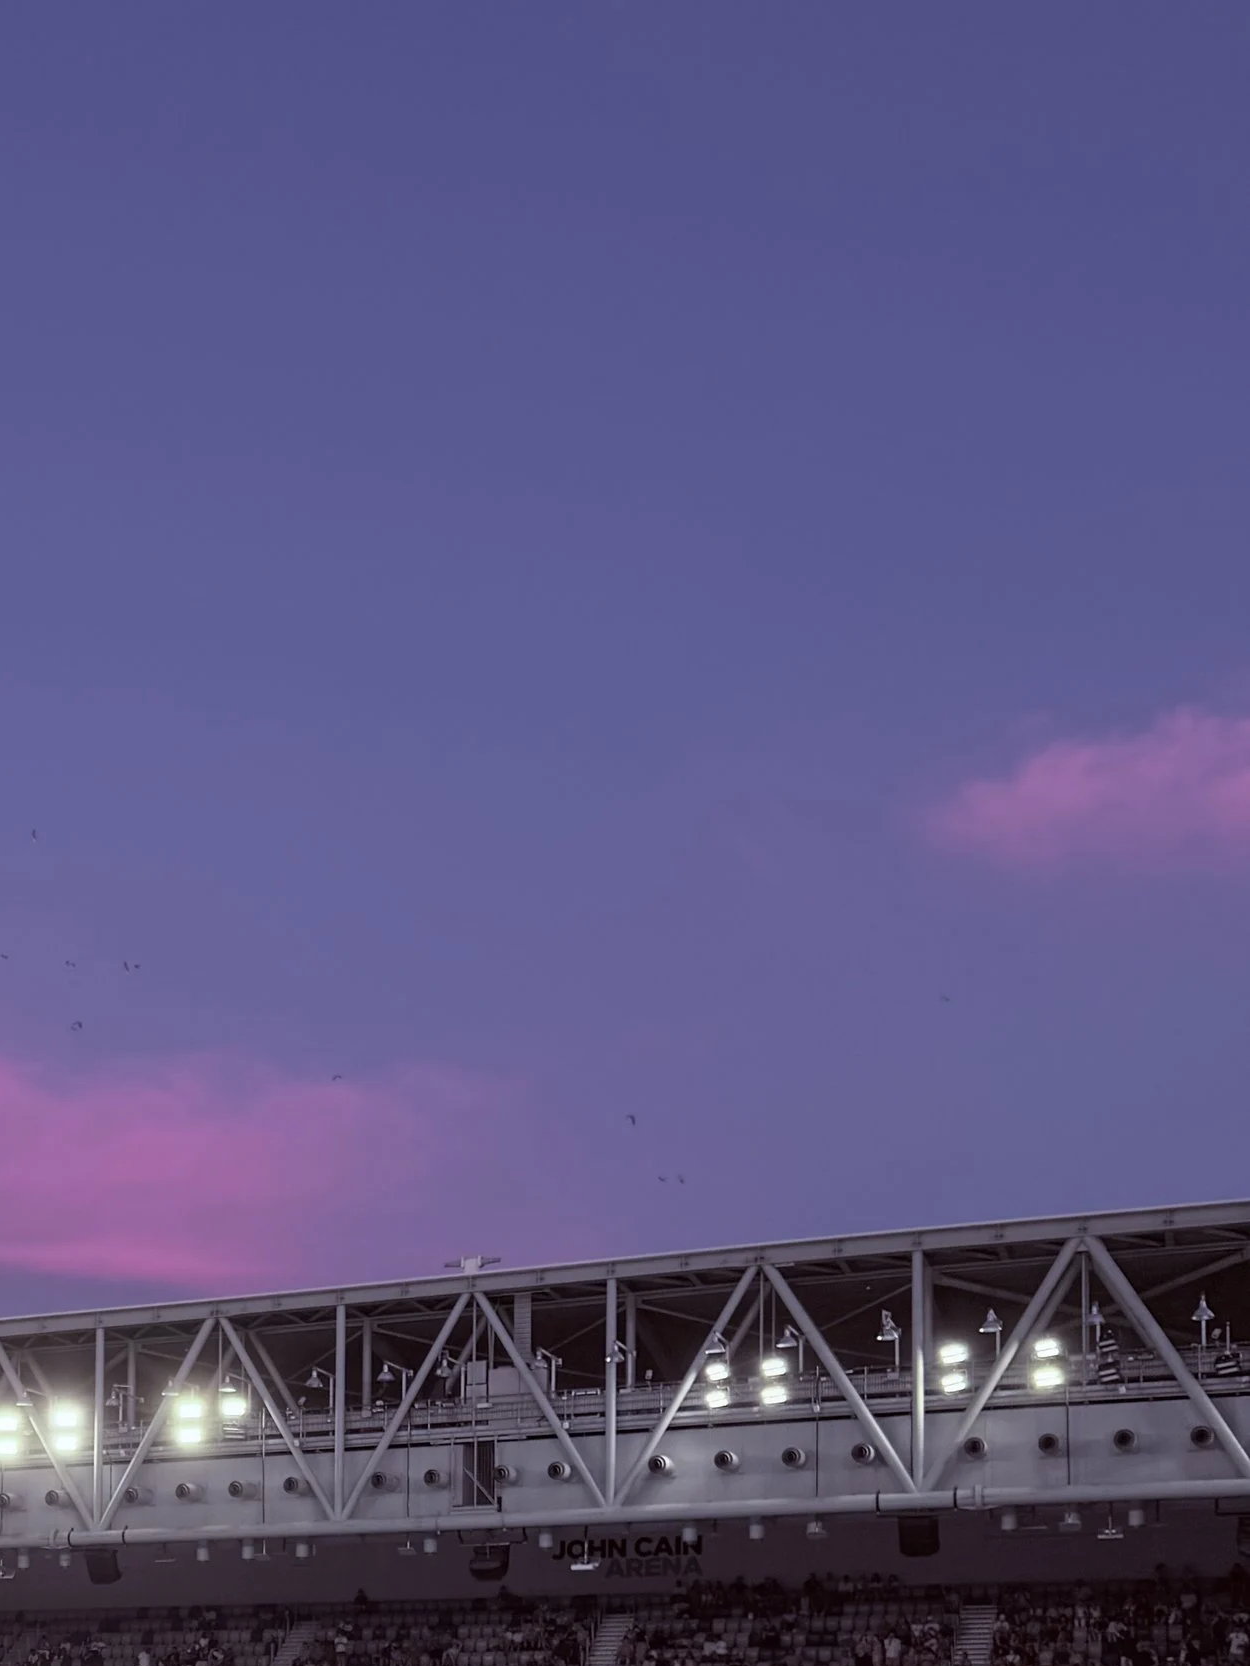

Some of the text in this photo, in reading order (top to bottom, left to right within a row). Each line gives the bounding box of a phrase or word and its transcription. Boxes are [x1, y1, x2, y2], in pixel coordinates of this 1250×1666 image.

[552, 1535, 703, 1559] JOHN CAIN
[605, 1556, 702, 1578] ARENA
